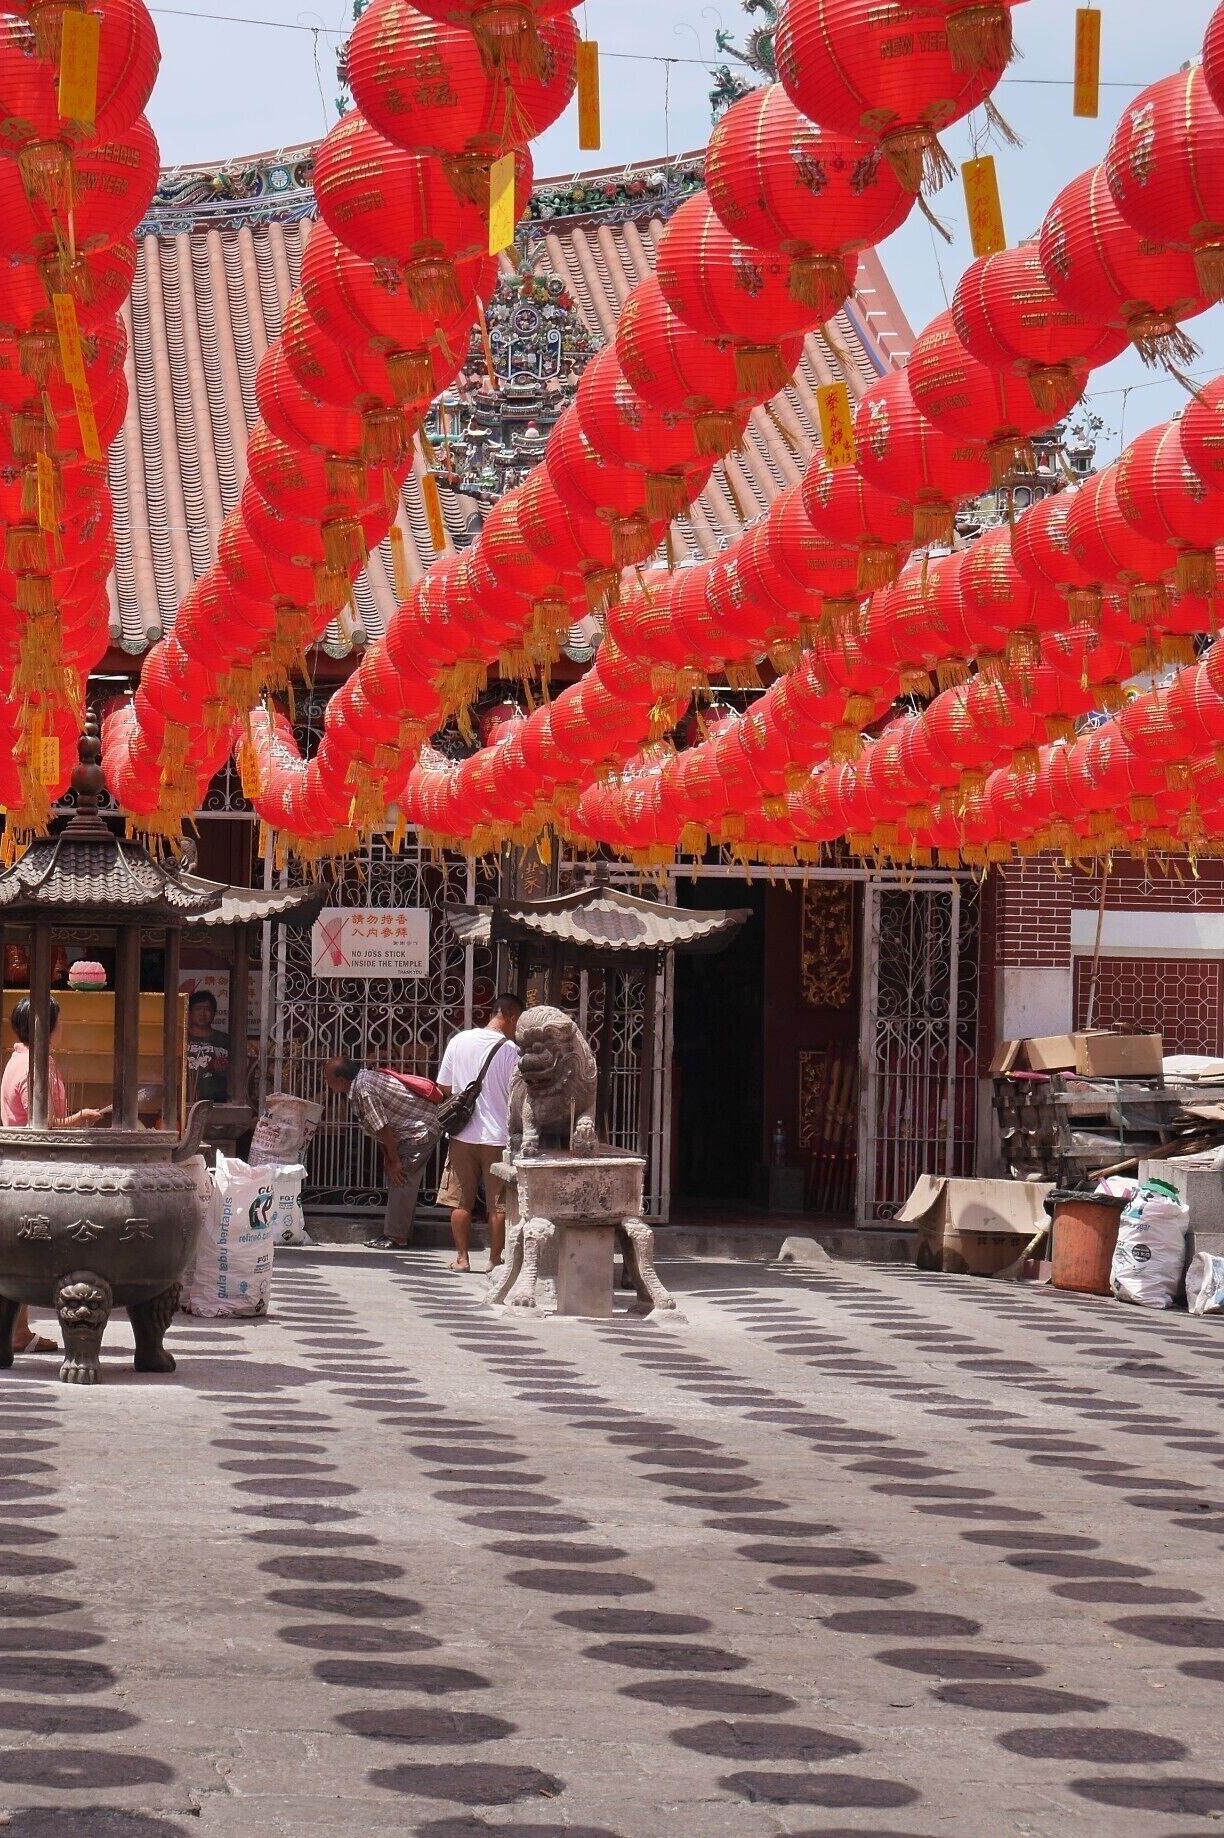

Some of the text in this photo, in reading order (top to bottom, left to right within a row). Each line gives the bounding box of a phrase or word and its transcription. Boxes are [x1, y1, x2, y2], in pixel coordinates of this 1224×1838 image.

[880, 31, 949, 59] NEW YEA
[101, 172, 129, 195] YEAR
[351, 914, 408, 925] 請勿持香
[351, 950, 406, 958] NO JOSS STICK
[351, 960, 423, 968] INSIDE THE TEMPLE
[258, 1185, 274, 1195] GU
[217, 1197, 233, 1246] bertapis
[217, 1276, 229, 1299] gula
